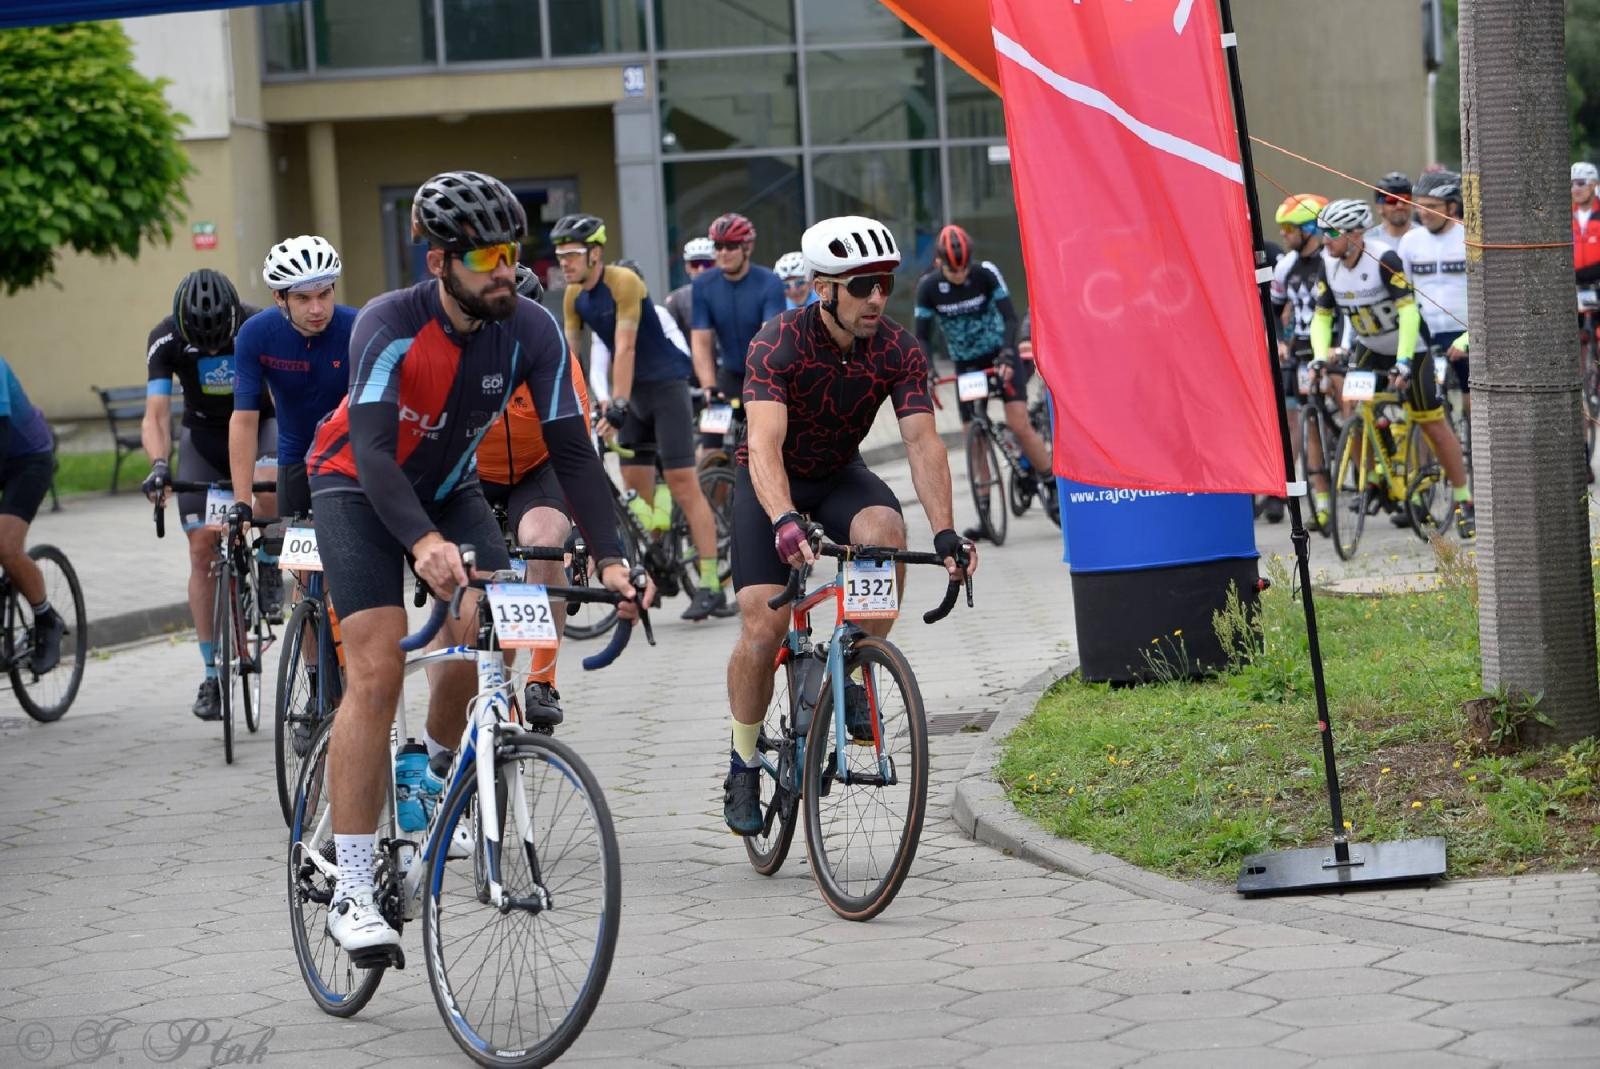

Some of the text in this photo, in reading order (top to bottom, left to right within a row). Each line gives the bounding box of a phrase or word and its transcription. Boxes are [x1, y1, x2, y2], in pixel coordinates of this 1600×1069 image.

[481, 378, 504, 389] GO!
[411, 427, 441, 440] THE
[847, 578, 894, 597] 1327
[497, 603, 550, 623] 1392
